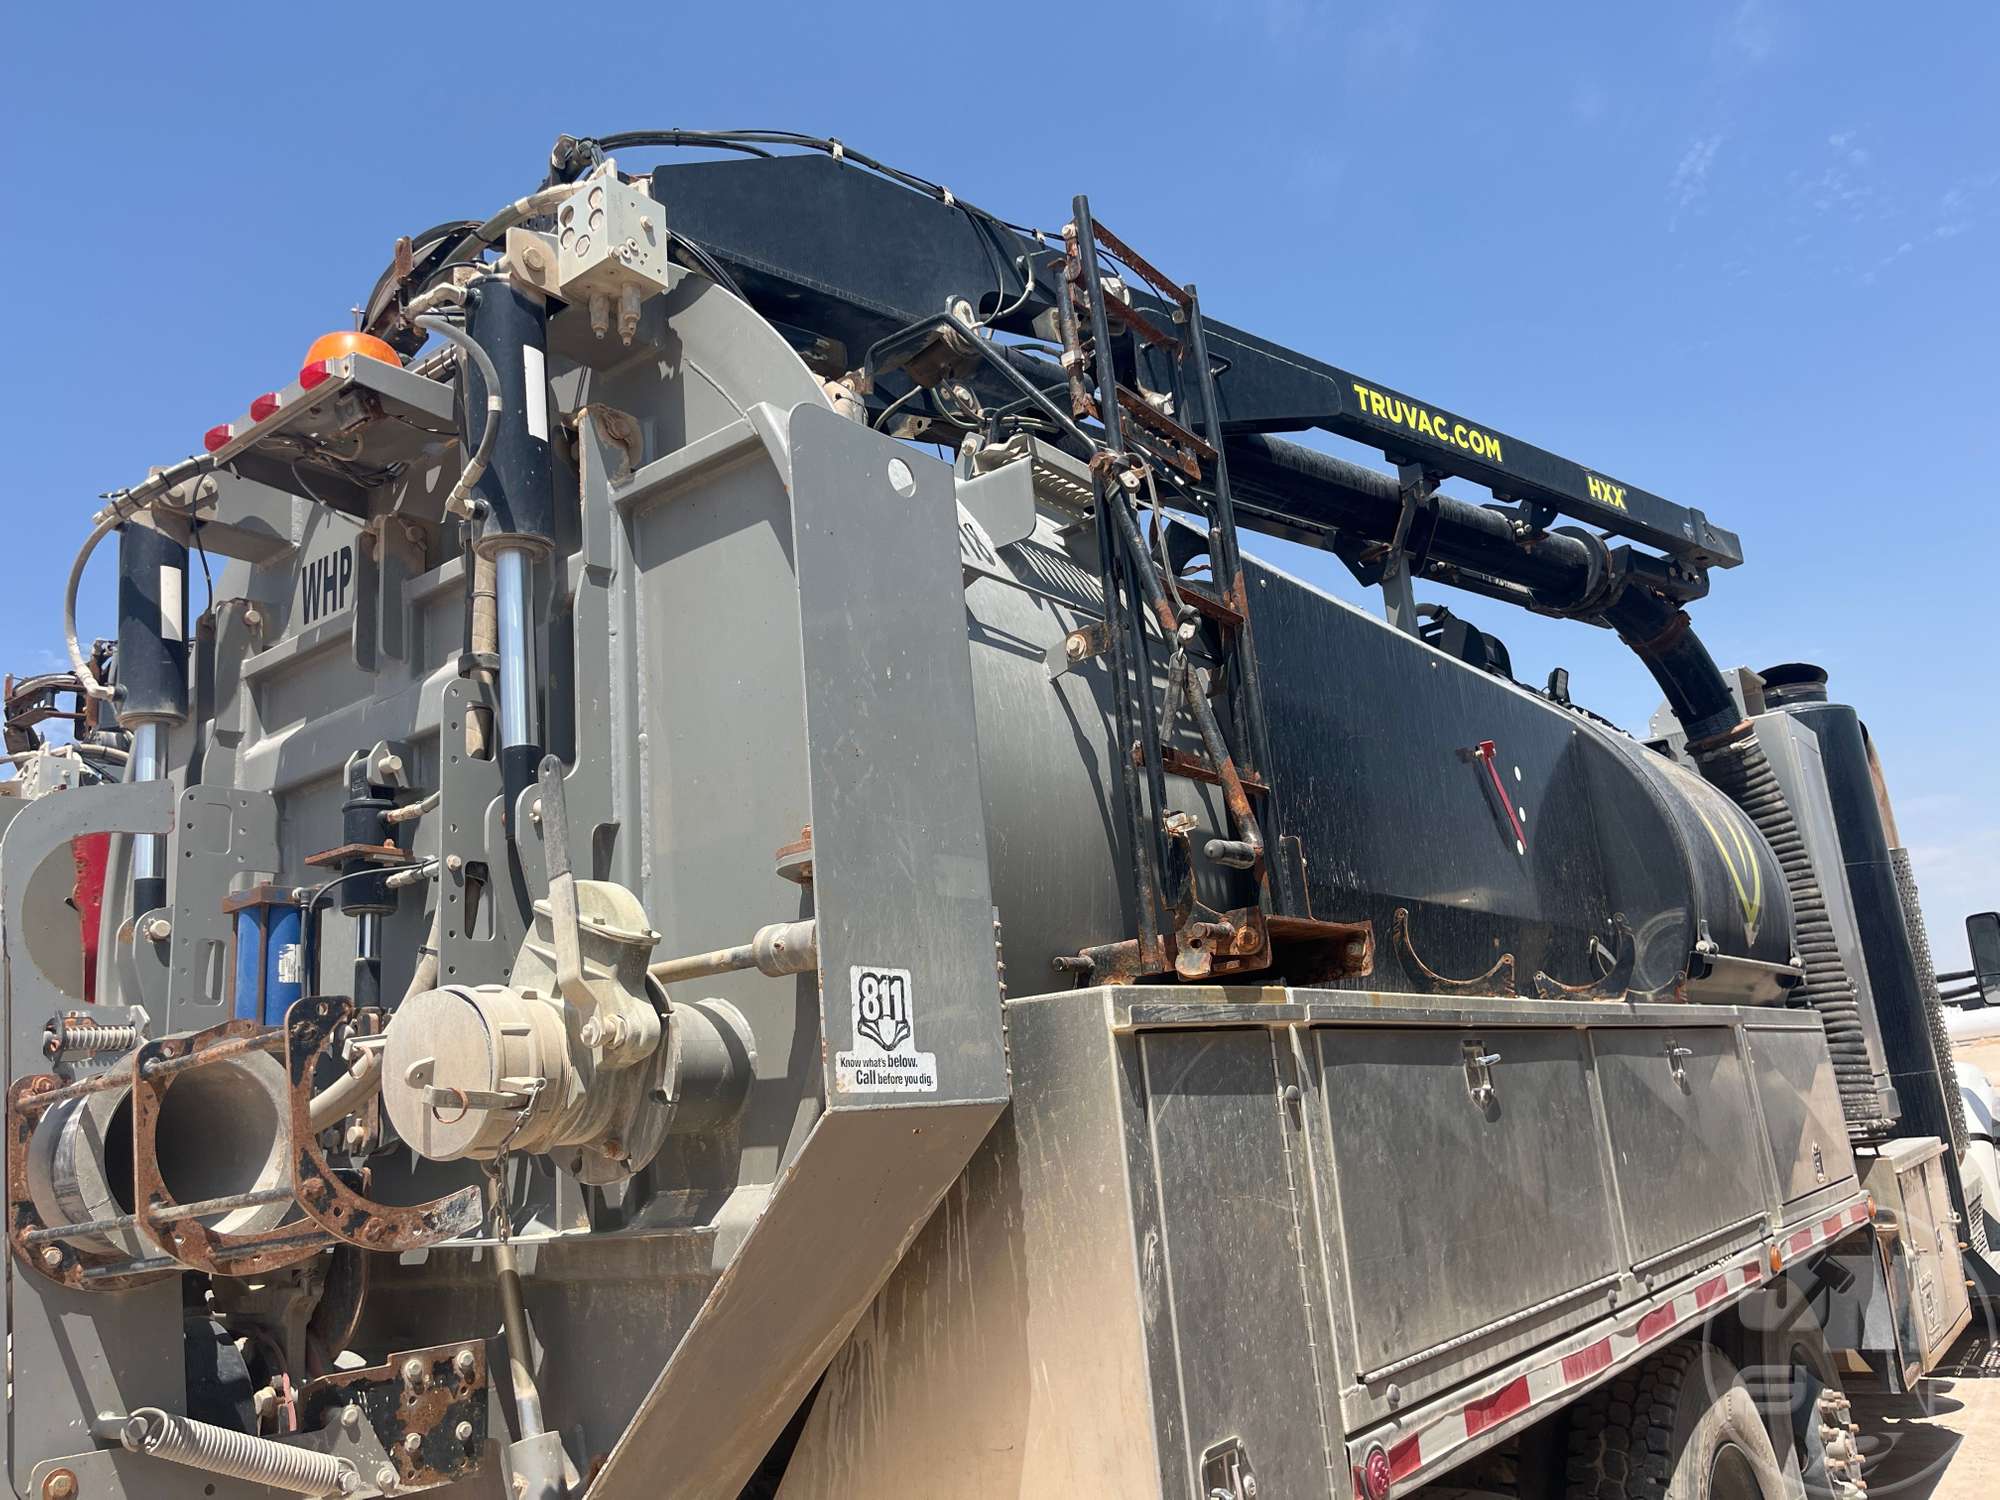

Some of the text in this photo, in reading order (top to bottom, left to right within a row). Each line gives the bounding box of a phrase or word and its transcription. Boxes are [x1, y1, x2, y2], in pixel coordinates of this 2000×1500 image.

[1353, 383, 1503, 462] TRUVAC.COM
[1588, 476, 1626, 510] HXX
[302, 546, 352, 625] WHP
[858, 972, 905, 1020] 811
[840, 1054, 918, 1068] Know what's below.
[856, 1069, 934, 1087] Call before you dig.
